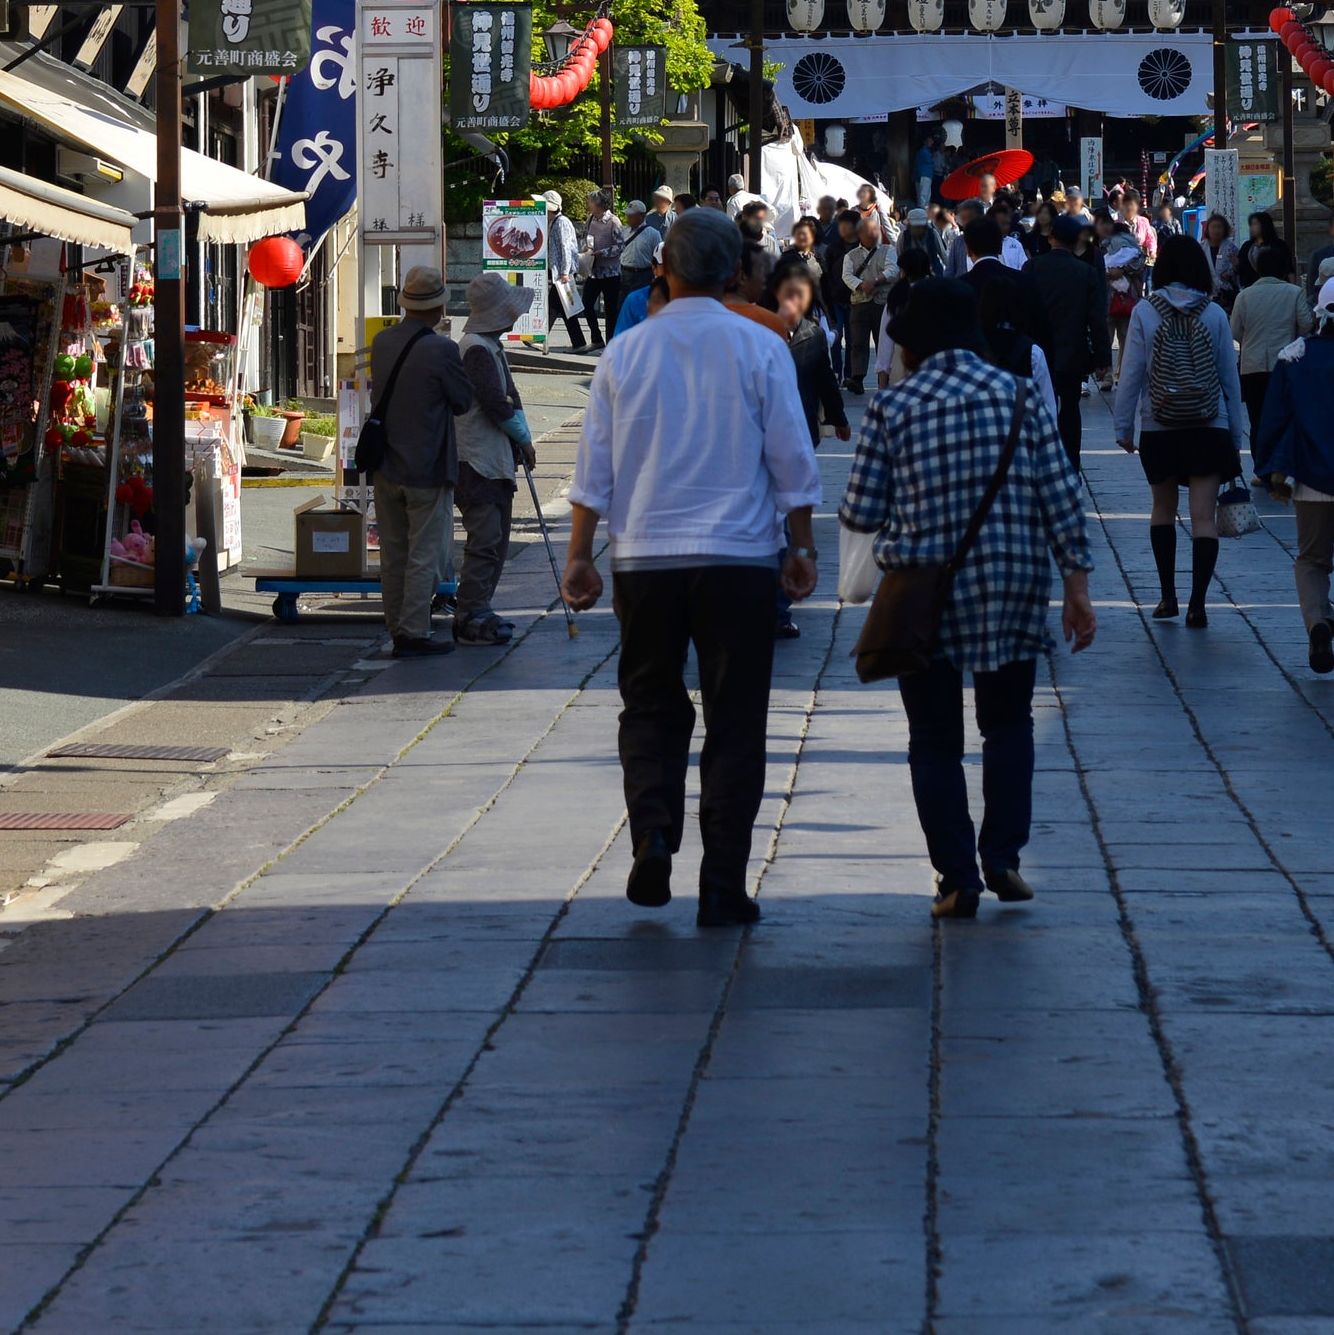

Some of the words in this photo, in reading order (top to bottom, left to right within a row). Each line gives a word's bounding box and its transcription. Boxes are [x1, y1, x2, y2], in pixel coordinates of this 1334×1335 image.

[370, 16, 427, 37] 歓迎
[499, 10, 516, 84] 信州善光寺
[195, 48, 299, 68] 元善町商盛会
[471, 10, 494, 114] 仲見世通り
[366, 67, 395, 180] 浄久寺
[372, 217, 391, 232] 様
